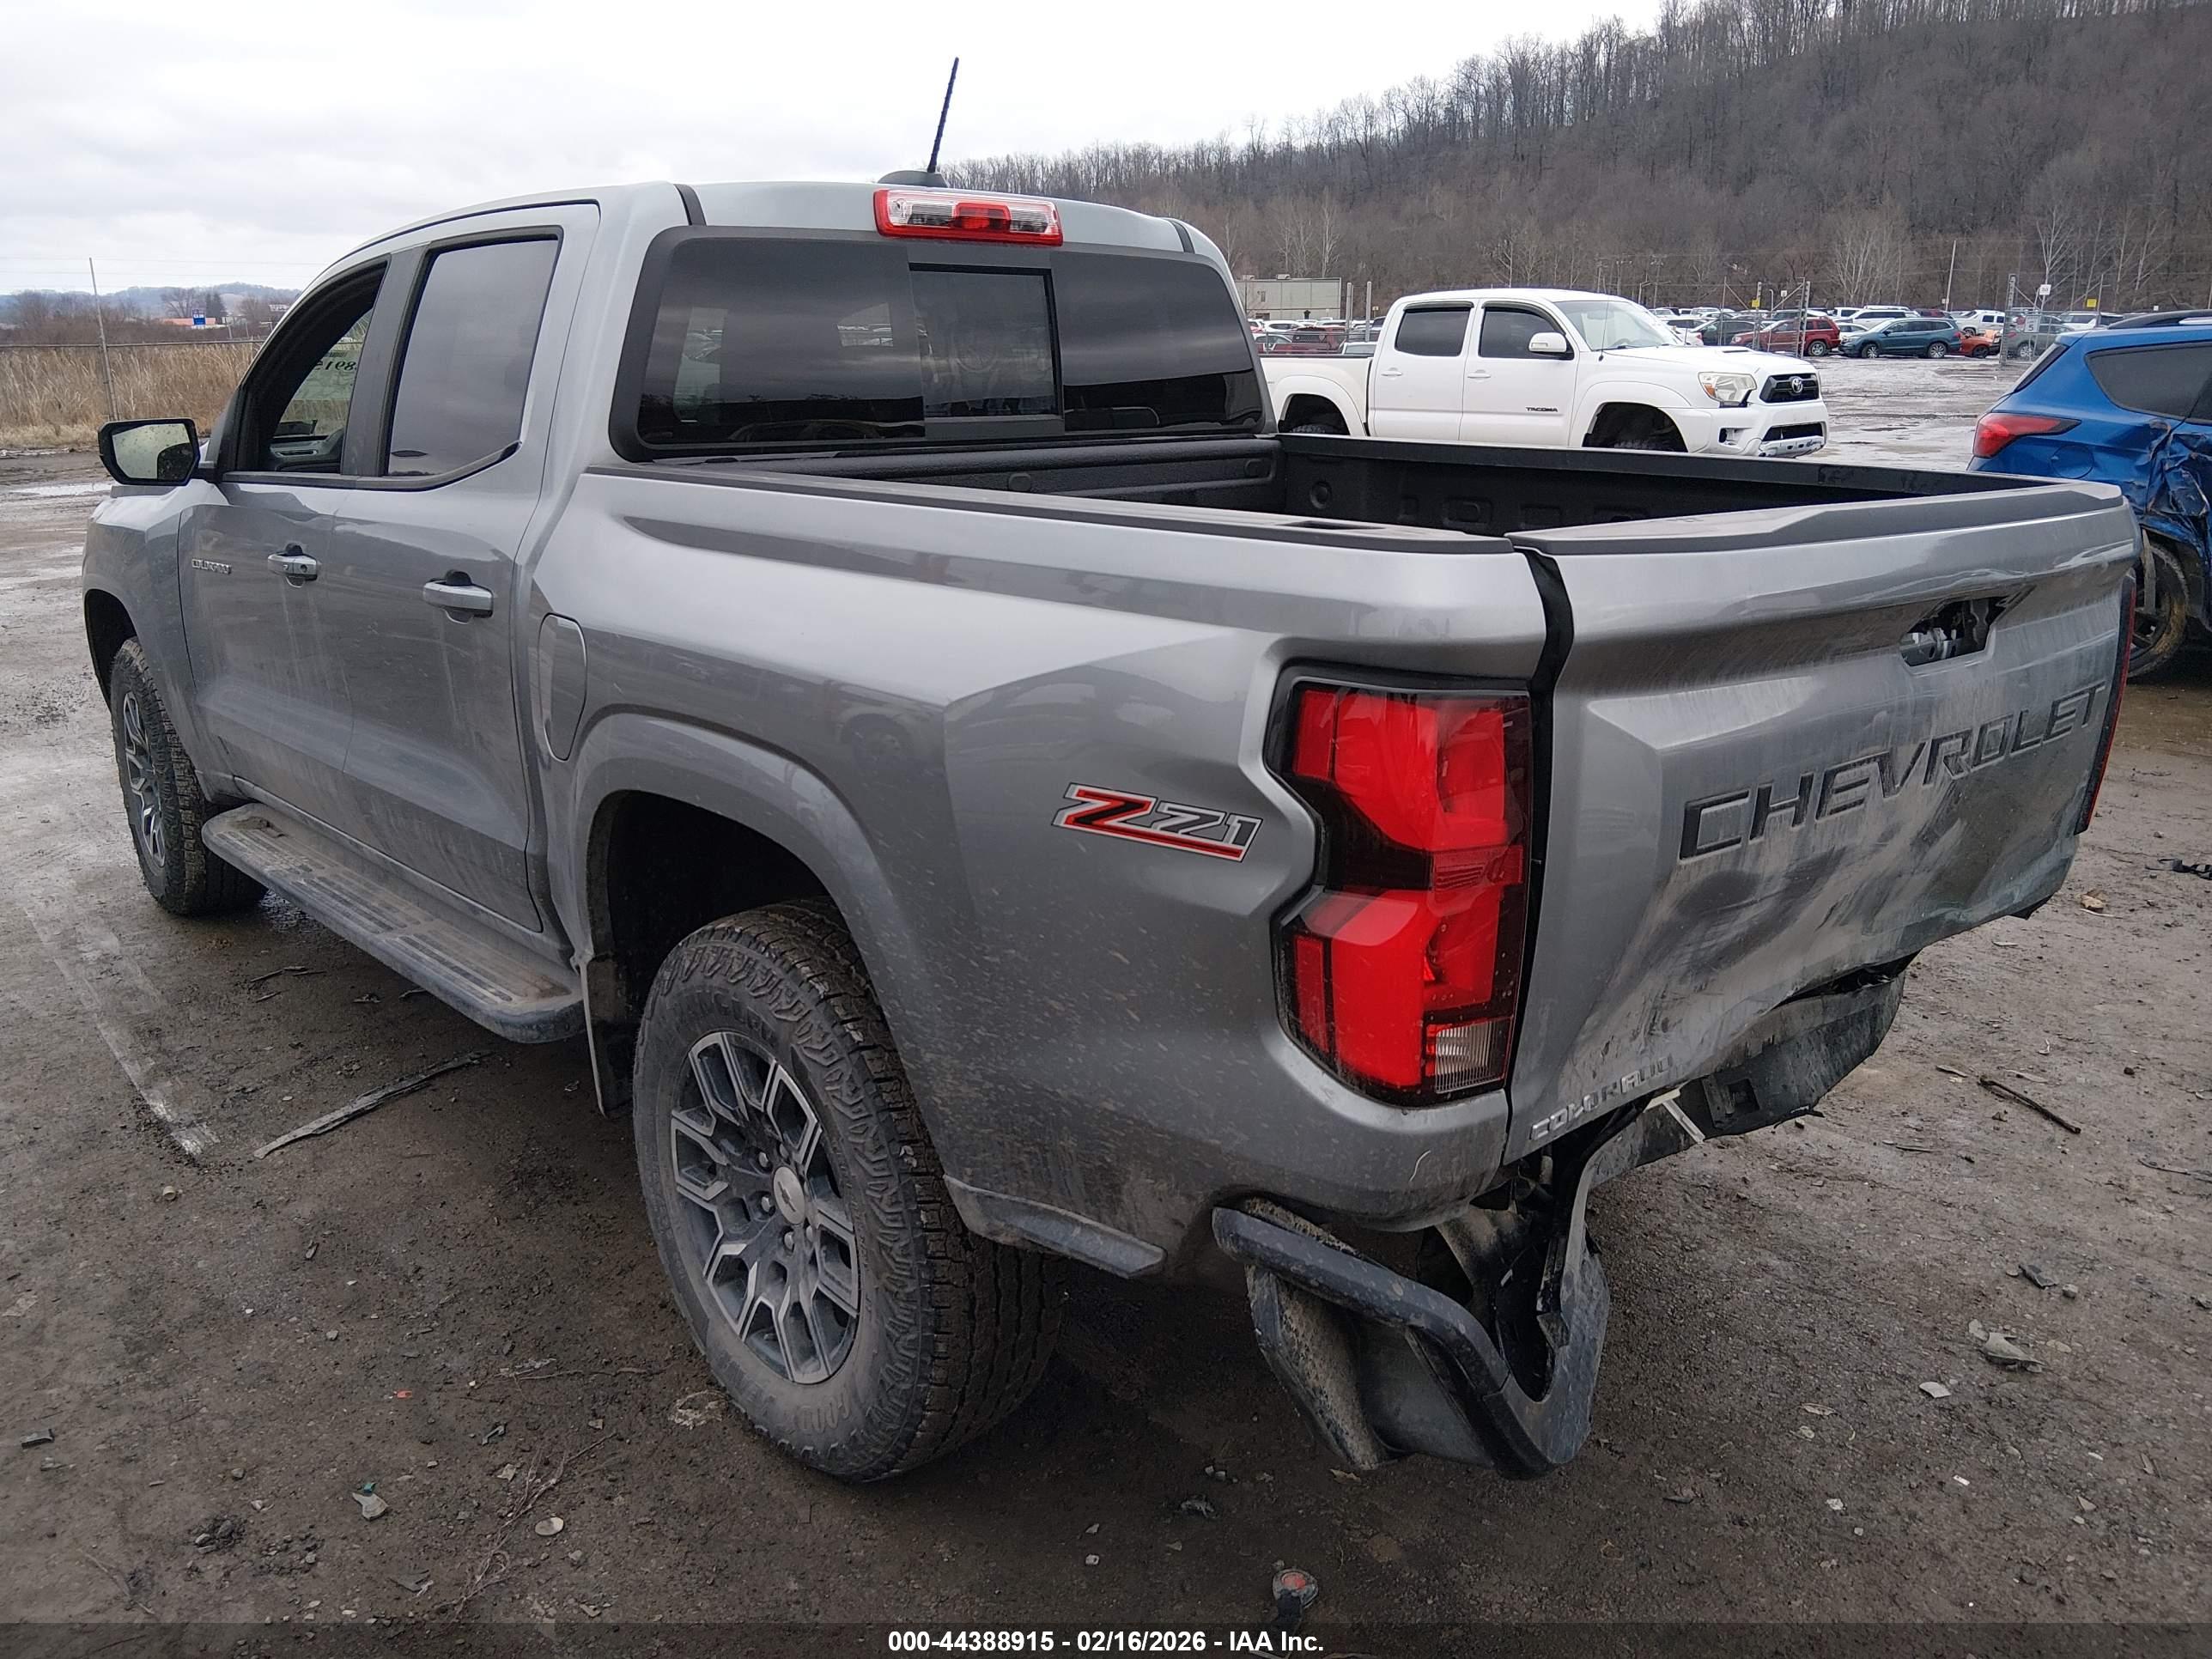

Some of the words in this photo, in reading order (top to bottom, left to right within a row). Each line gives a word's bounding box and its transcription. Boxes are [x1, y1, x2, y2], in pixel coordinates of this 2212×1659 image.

[1679, 682, 2106, 860] CHEVROLET
[1051, 782, 1263, 862] Z71
[1529, 1054, 1673, 1140] COLORADO
